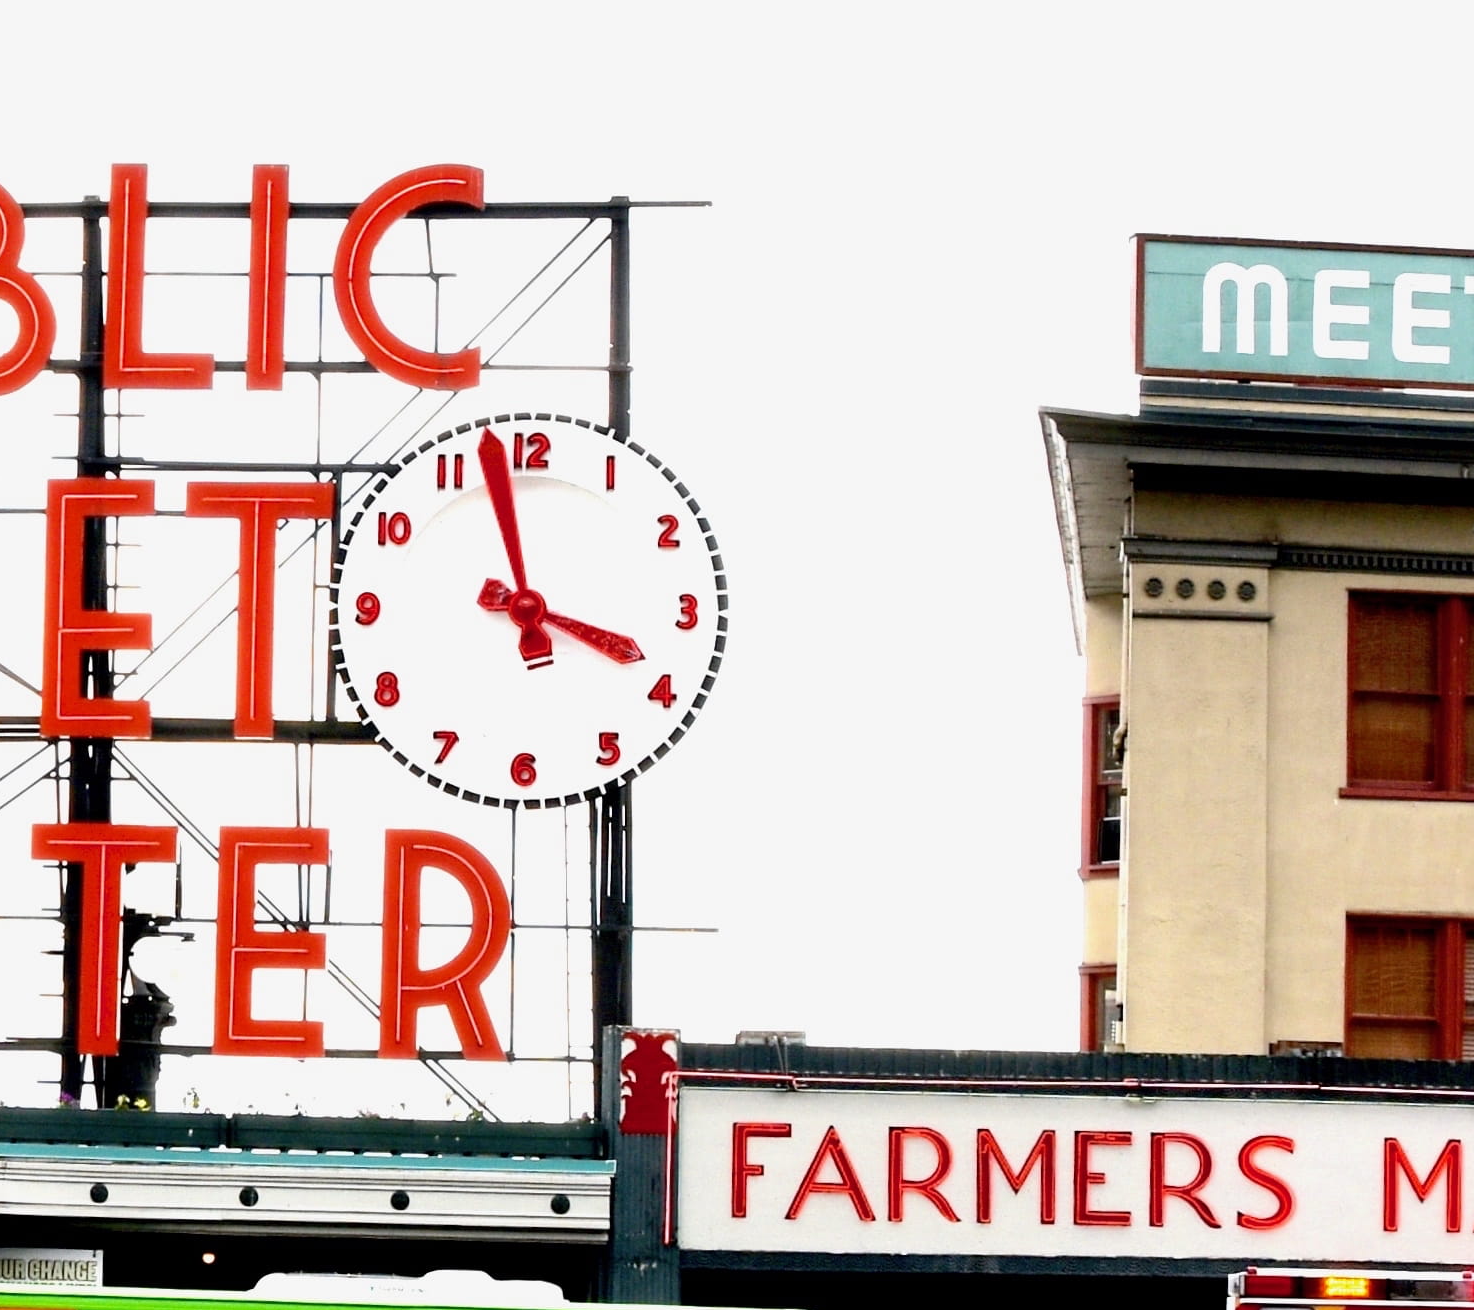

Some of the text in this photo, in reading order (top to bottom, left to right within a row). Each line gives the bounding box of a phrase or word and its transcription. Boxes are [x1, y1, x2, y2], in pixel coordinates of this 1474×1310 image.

[513, 432, 551, 470] 12
[436, 453, 464, 490] 11
[605, 455, 616, 491] 1
[377, 511, 412, 546] 10
[657, 514, 680, 548] 2
[355, 592, 381, 626] 9
[675, 594, 699, 630] 3
[374, 671, 400, 707] 8
[647, 674, 677, 709] 4
[432, 730, 459, 765] 7
[596, 731, 621, 766] 5
[510, 752, 537, 787] 6
[730, 1120, 1297, 1231] FARMERS
[27, 1258, 99, 1283] CHANGE
